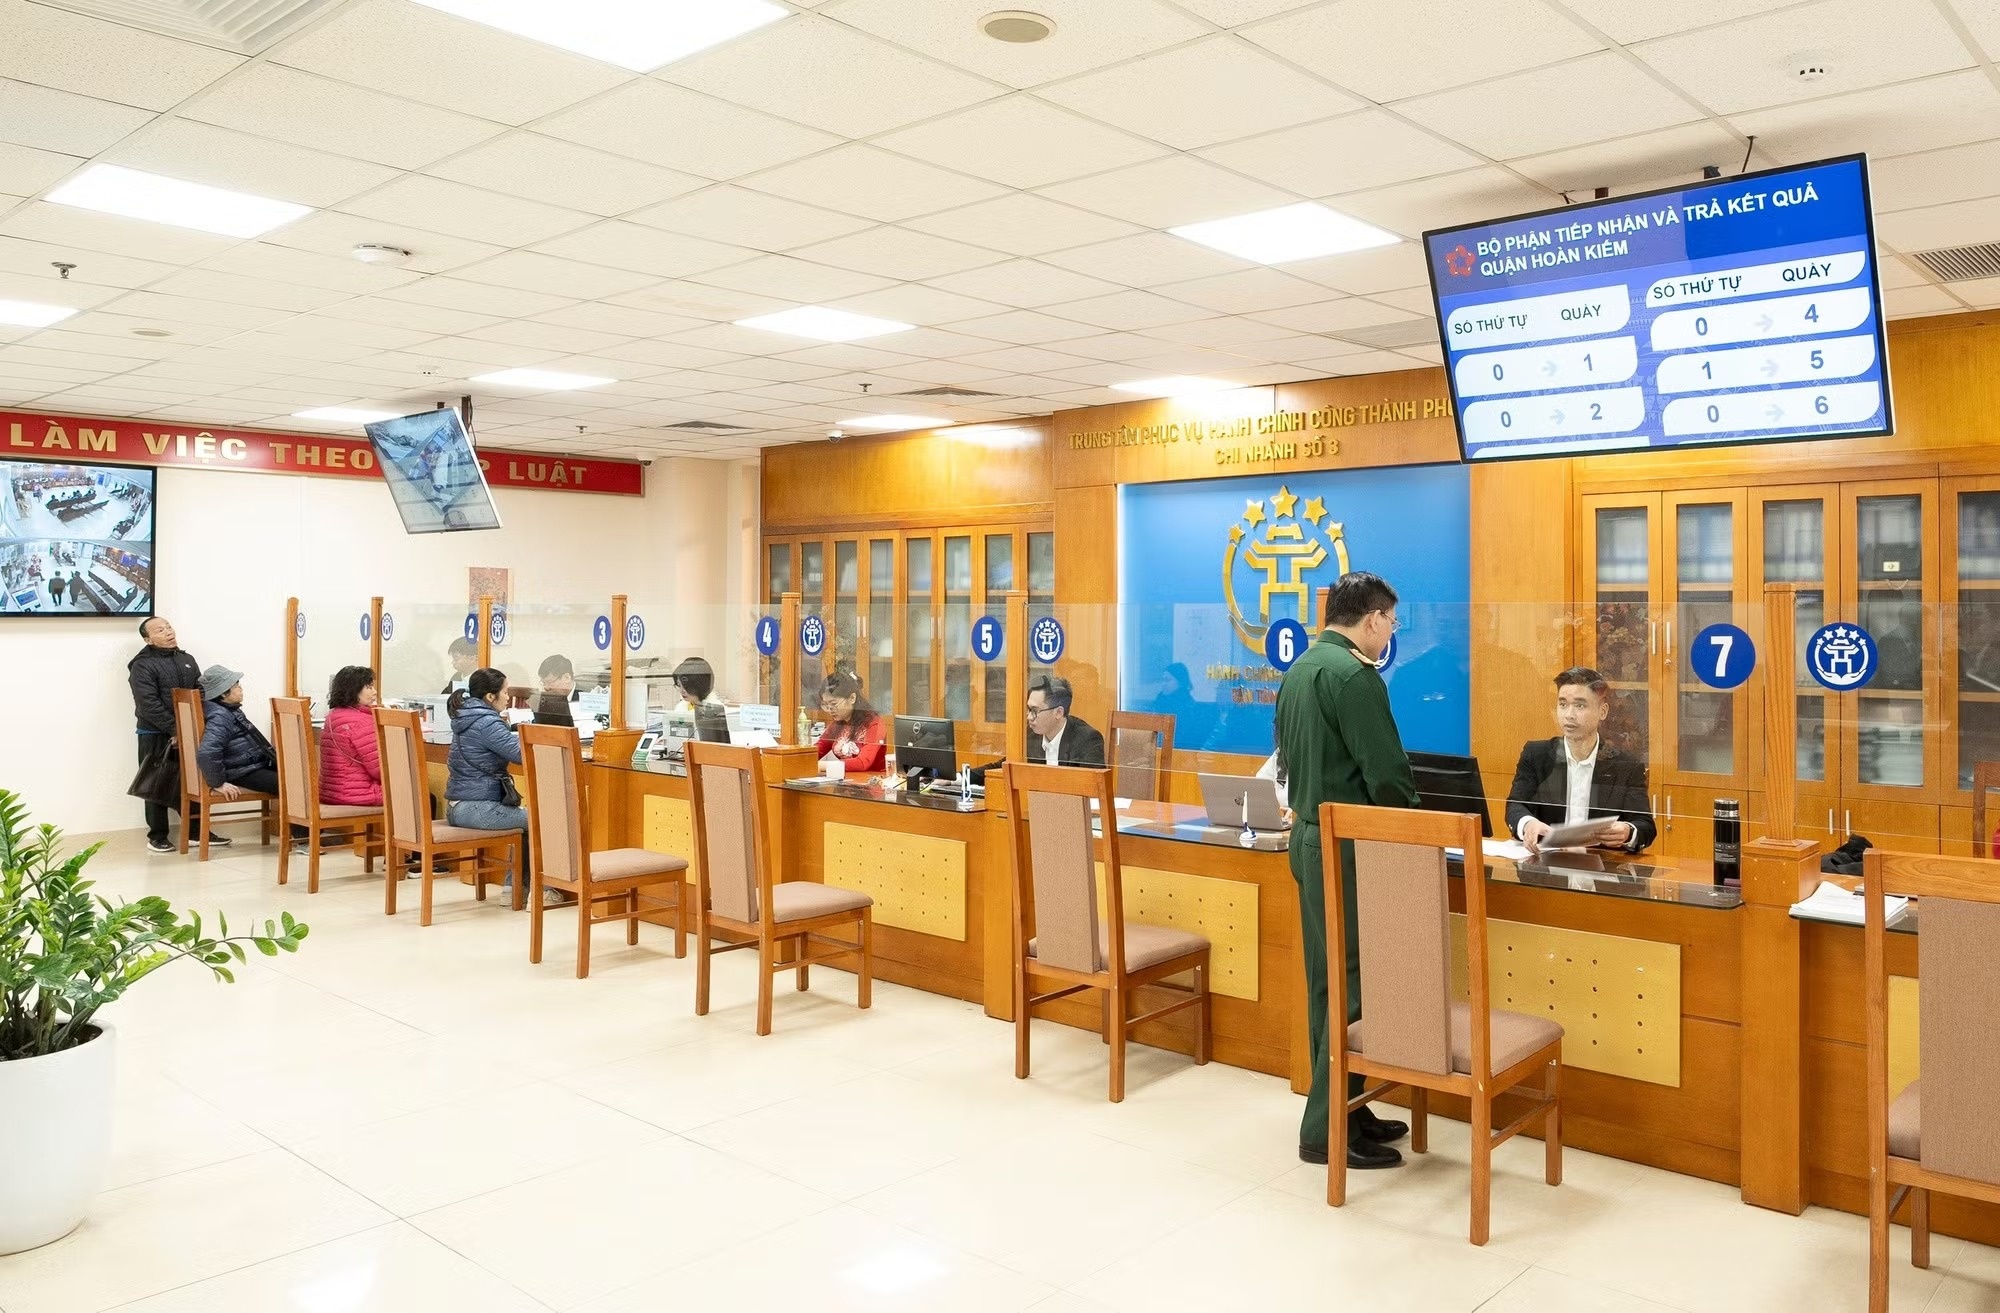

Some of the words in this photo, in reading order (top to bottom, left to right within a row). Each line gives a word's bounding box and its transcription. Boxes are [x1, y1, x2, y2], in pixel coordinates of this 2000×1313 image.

[1477, 237, 1501, 257] BỘ
[1505, 230, 1551, 251] PHẬN
[1598, 214, 1648, 236] NHẬN
[1652, 205, 1680, 227] VÀ
[1683, 198, 1723, 222] TRẢ
[1772, 181, 1819, 208] QUẢ
[1480, 256, 1528, 277] QUẬN
[1531, 246, 1581, 269] HOÀN
[1680, 276, 1714, 295] THỨ
[1719, 275, 1742, 292] TỰ
[1508, 314, 1528, 330] TỰ
[1695, 317, 1708, 336] 0
[1804, 304, 1819, 323] 4
[1493, 363, 1504, 381] 0
[1583, 353, 1593, 371] 1
[1701, 361, 1712, 380] 1
[1810, 350, 1824, 369] 5
[1500, 411, 1512, 428] 0
[1590, 403, 1603, 421] 2
[1707, 404, 1719, 423] 0
[1814, 395, 1829, 415] 6
[1068, 431, 1112, 449] TRUNG
[1112, 425, 1141, 446] TÂM
[1141, 423, 1179, 448] PHỤC
[1258, 409, 1306, 434] CHÍNH
[1359, 398, 1417, 424] THÀNH
[10, 420, 117, 452] LÀM
[142, 432, 247, 463] VIỆC
[268, 442, 373, 470] THEO
[1215, 446, 1241, 464] CHI
[1246, 441, 1297, 463] NHÁNH
[1302, 435, 1326, 457] SỐ
[1329, 439, 1339, 455] 3
[509, 460, 587, 487] LUẬT
[363, 617, 368, 636] 1
[468, 618, 475, 638] 2
[599, 621, 606, 644] 3
[763, 622, 772, 647] 4
[981, 624, 993, 654] 5
[1279, 627, 1294, 663] 6
[1711, 636, 1733, 677] 7
